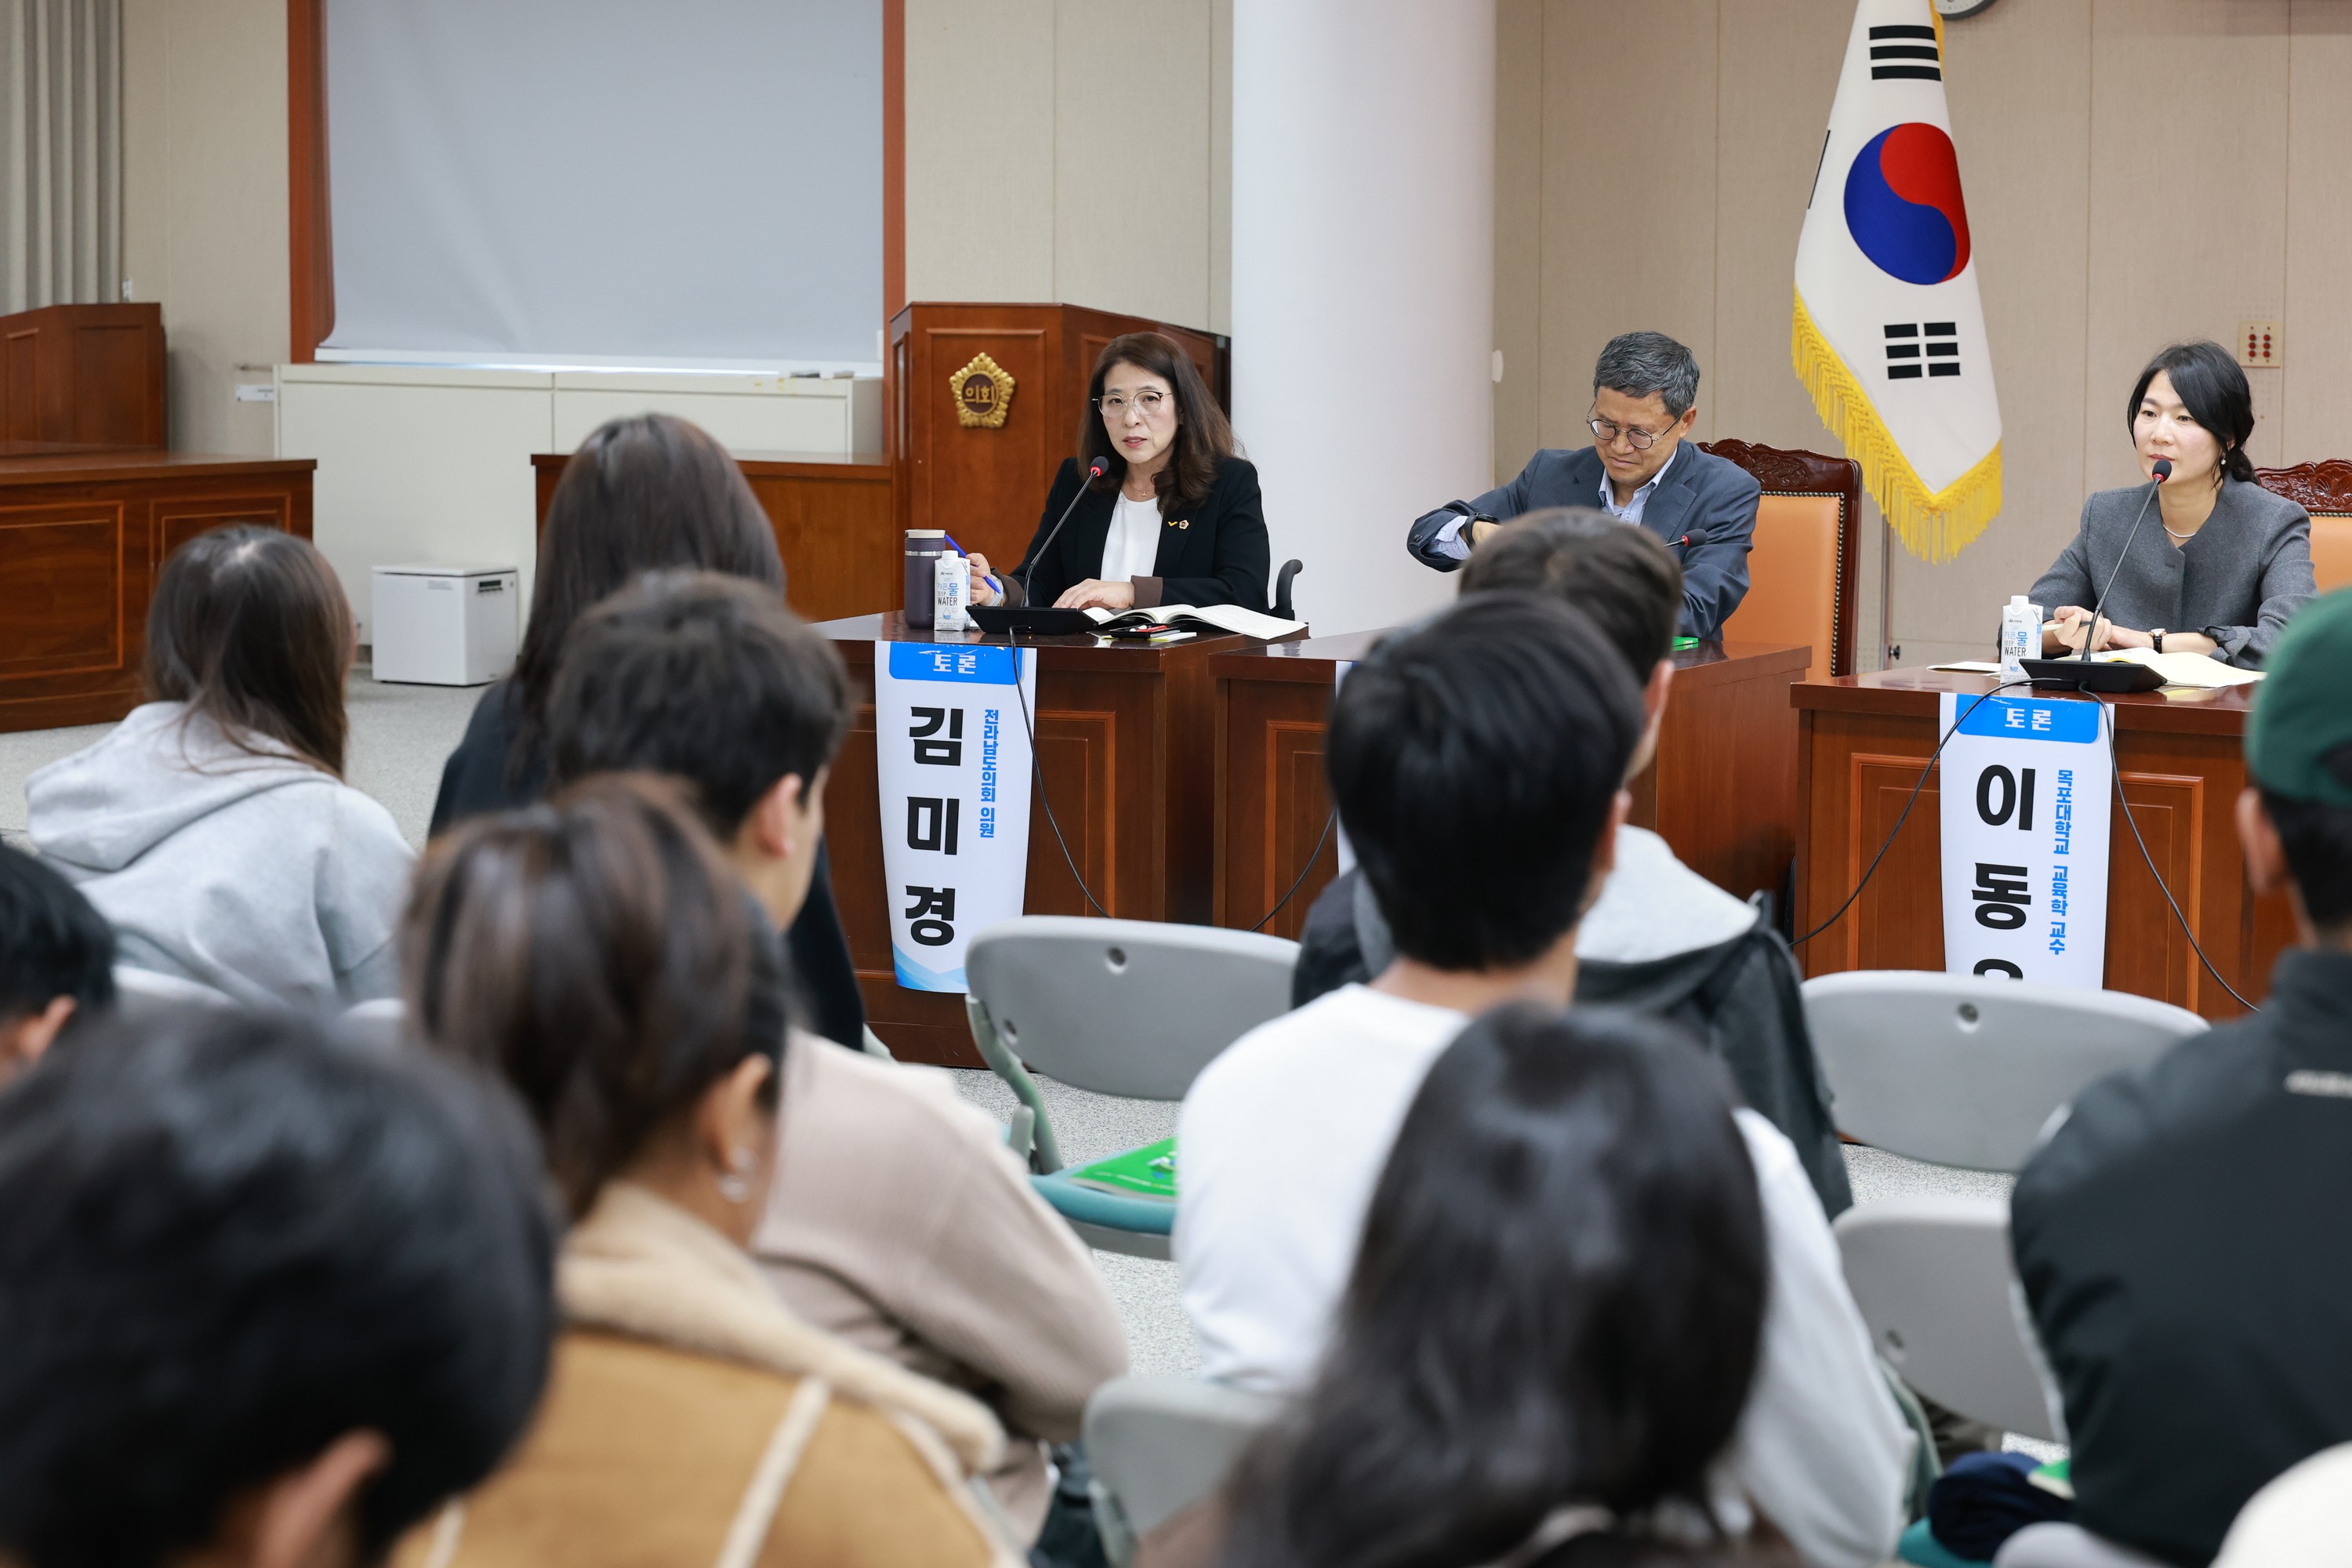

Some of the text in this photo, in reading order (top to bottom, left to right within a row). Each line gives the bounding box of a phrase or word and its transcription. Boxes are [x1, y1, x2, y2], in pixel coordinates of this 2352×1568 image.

[964, 384, 995, 404] 의회
[948, 583, 959, 596] 물
[938, 597, 957, 606] WATER
[2016, 631, 2028, 646] 물
[2005, 647, 2027, 657] WATER
[933, 654, 977, 675] 토론
[2005, 708, 2052, 731] 토론
[979, 709, 1000, 838] 전라남도의회 의원
[905, 706, 964, 946] 김미경
[2049, 769, 2073, 956] 목포대학교 교육학 교수
